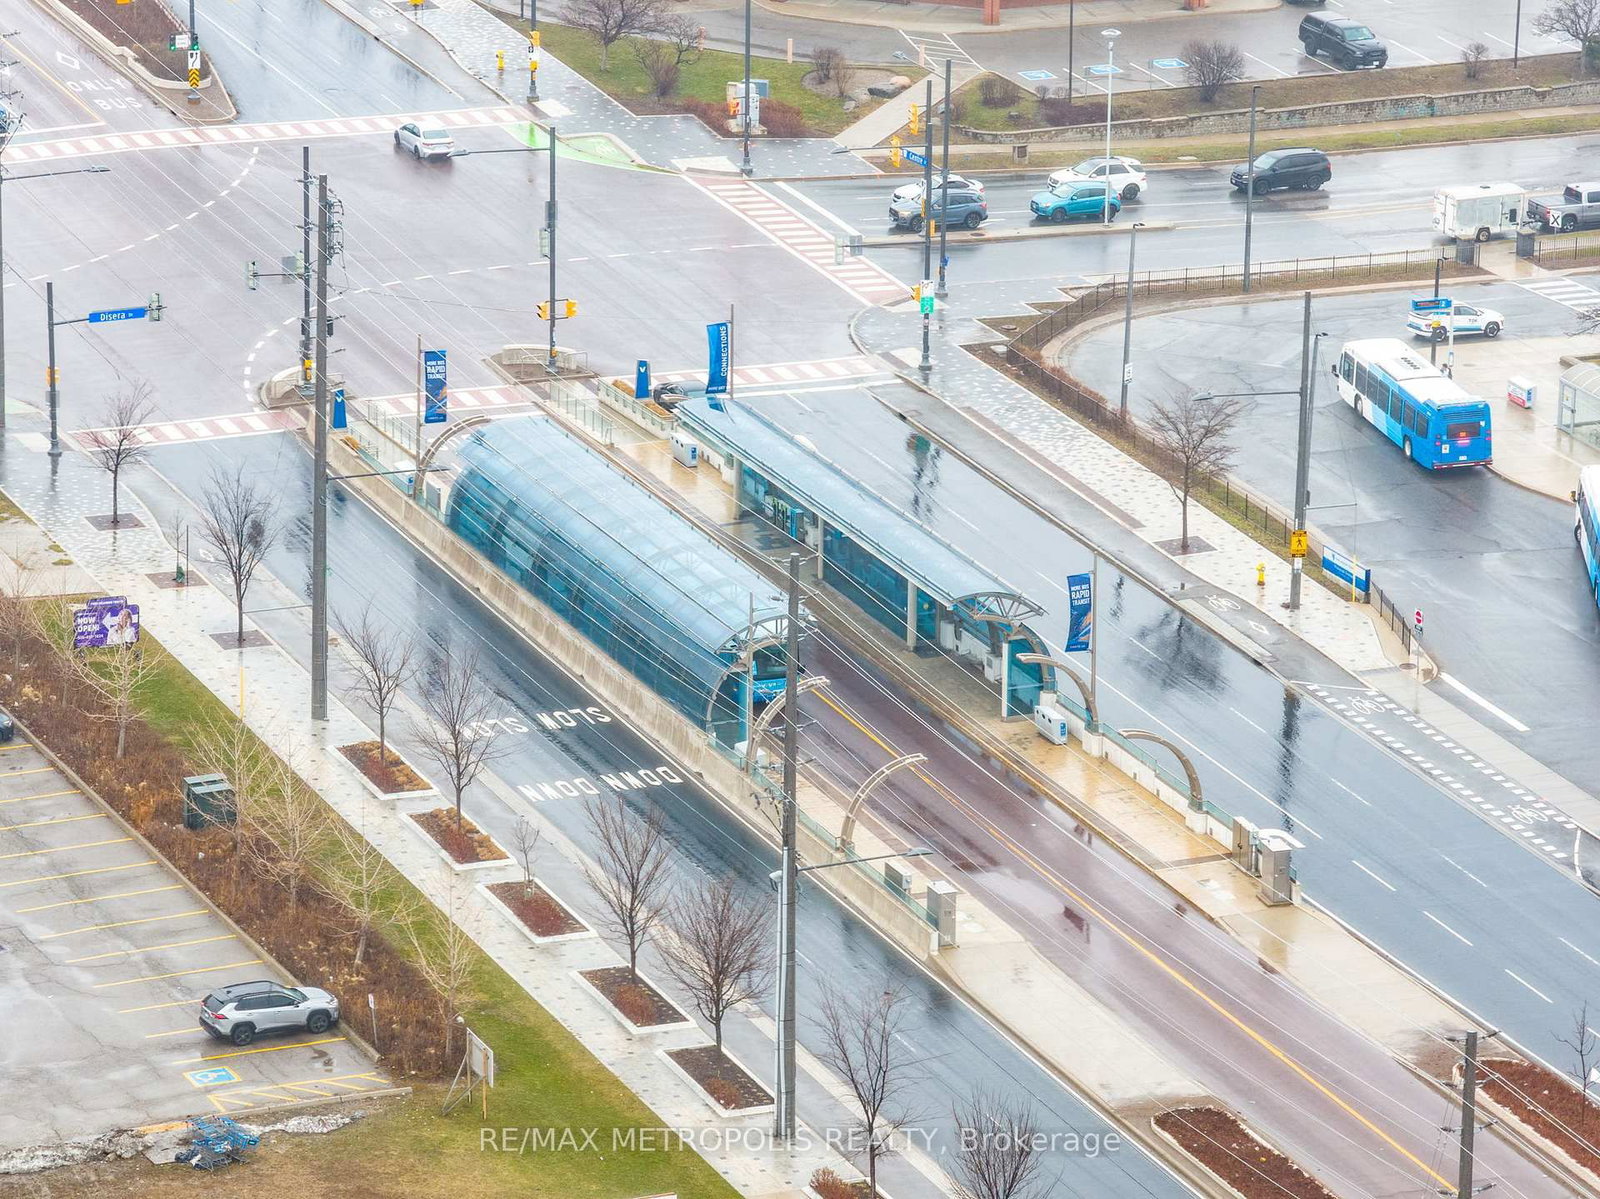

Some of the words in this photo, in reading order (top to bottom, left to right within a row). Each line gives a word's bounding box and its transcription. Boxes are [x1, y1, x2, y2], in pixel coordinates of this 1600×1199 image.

[66, 79, 127, 92] ONLY
[94, 97, 142, 110] BUS
[100, 312, 125, 321] Disera
[1071, 590, 1090, 600] RAPID
[1072, 598, 1090, 606] TRANSIT
[77, 616, 95, 625] NOW
[537, 706, 612, 730] SLOW
[601, 766, 684, 791] DOWN
[517, 777, 601, 802] DOWN
